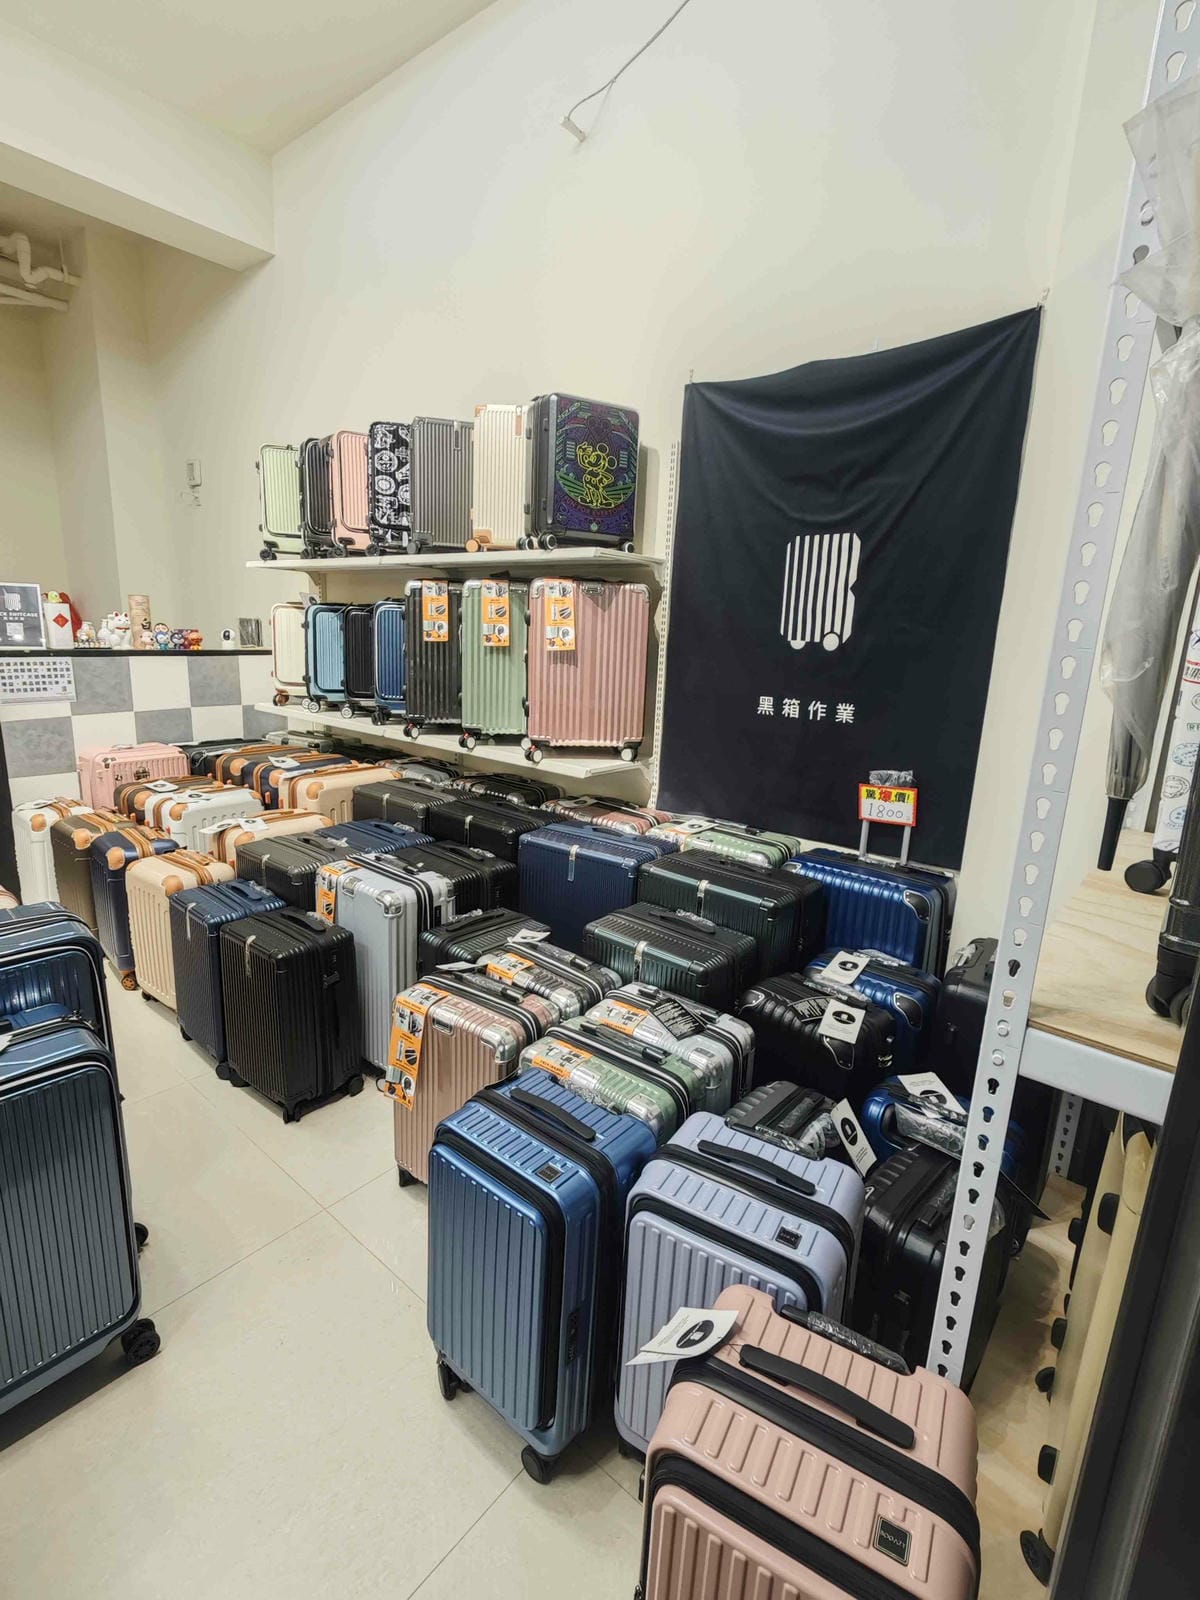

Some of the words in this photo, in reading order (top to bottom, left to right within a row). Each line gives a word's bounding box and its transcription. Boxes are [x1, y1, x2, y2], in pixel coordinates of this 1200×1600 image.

[757, 697, 856, 724] 黑箱作業
[868, 803, 904, 819] 1800
